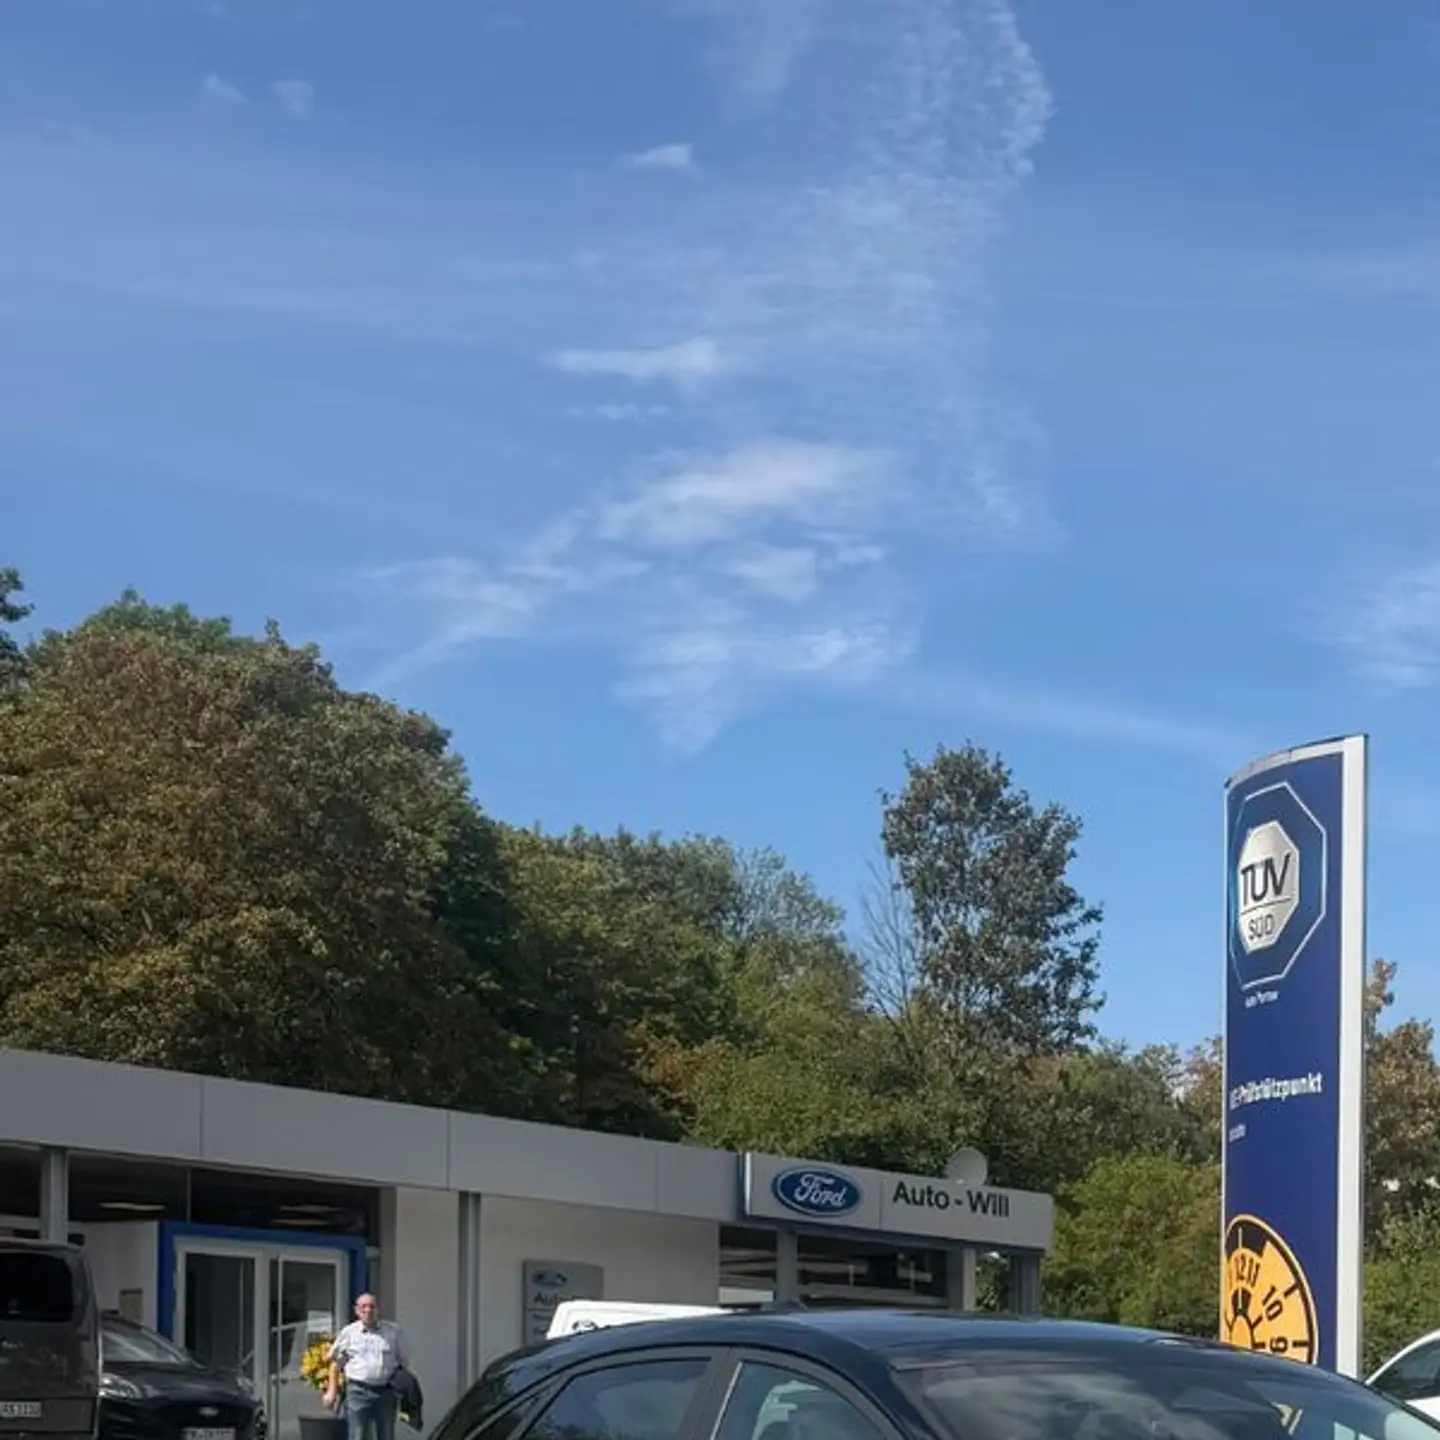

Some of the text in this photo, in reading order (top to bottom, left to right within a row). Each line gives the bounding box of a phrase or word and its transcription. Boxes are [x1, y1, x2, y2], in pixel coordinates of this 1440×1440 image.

[1248, 913, 1275, 941] SÜD
[794, 1170, 847, 1207] Ford
[893, 1181, 949, 1211] Auto
[967, 1189, 1010, 1218] Will
[1262, 1285, 1284, 1321] 10
